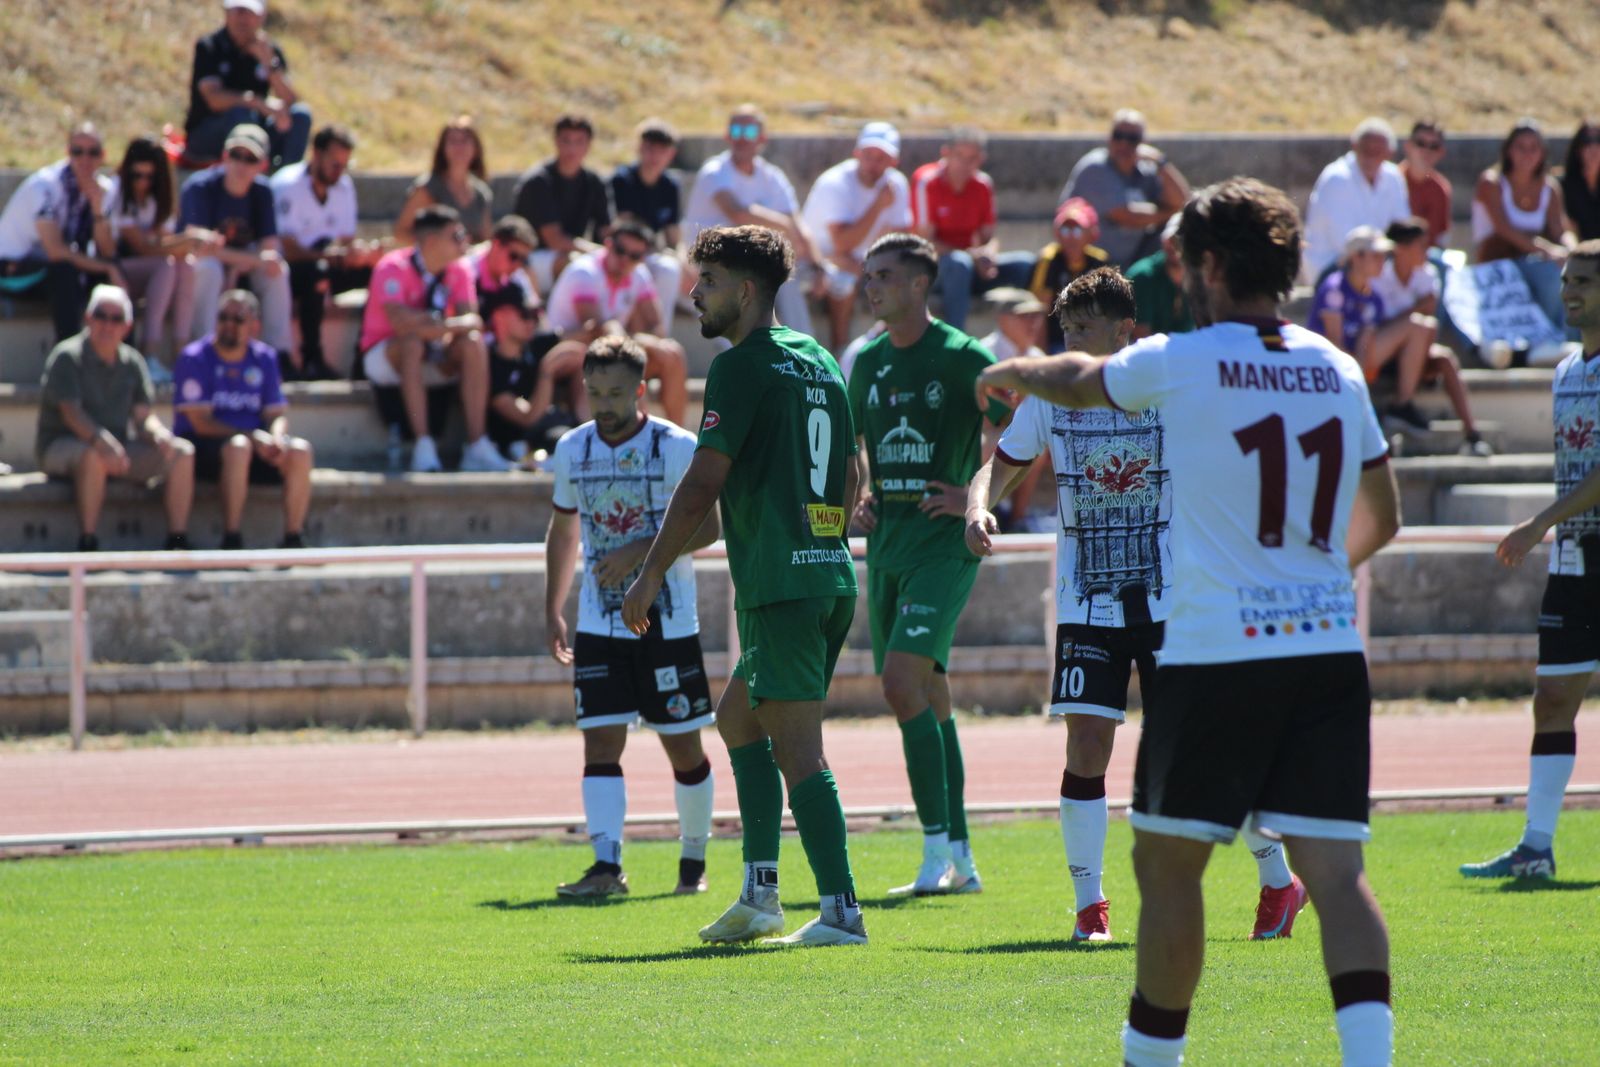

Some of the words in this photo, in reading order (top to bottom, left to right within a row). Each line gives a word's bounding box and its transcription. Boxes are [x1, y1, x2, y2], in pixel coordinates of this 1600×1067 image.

[1218, 360, 1341, 394] MANCEBO
[807, 408, 832, 498] 9
[1232, 412, 1344, 554] 11
[1059, 665, 1085, 698] 10
